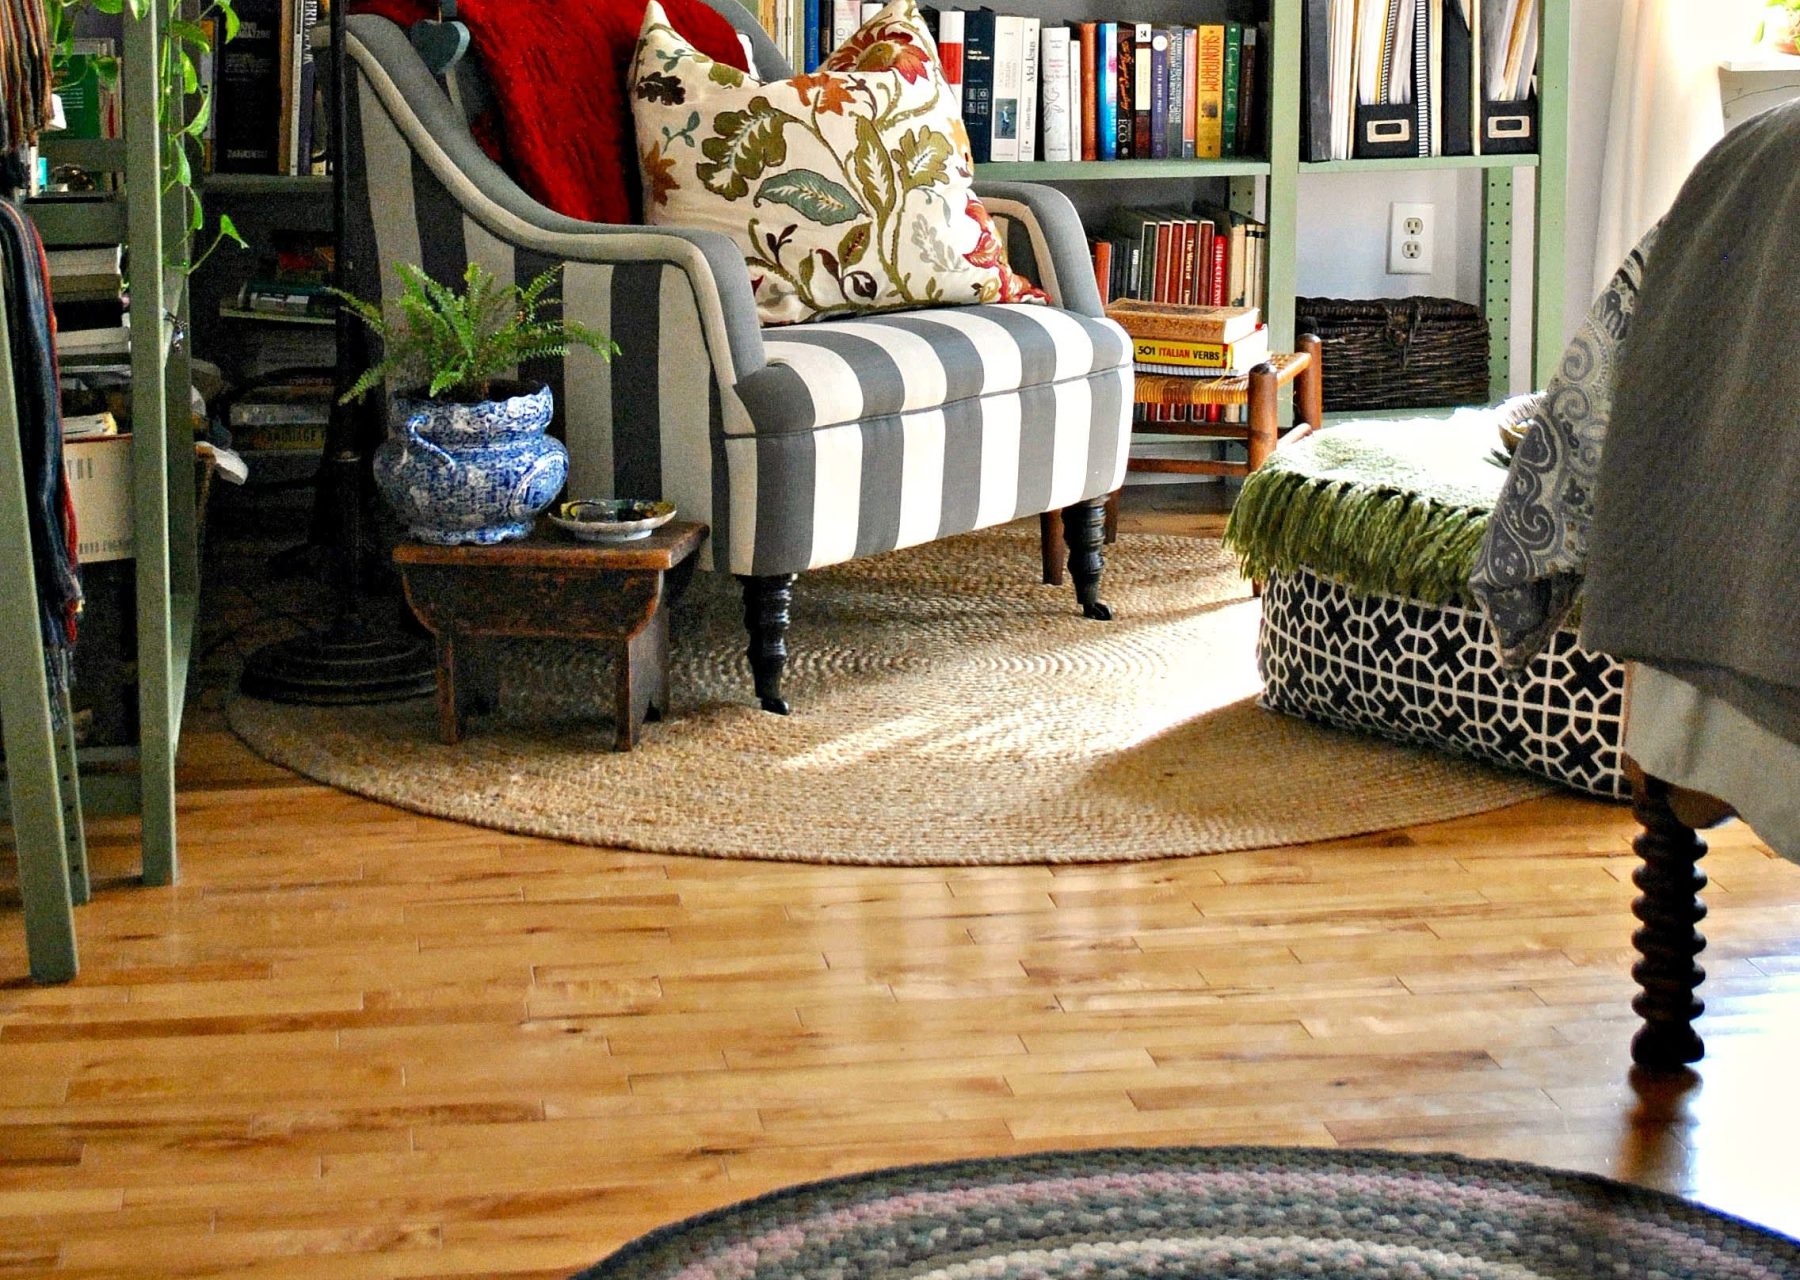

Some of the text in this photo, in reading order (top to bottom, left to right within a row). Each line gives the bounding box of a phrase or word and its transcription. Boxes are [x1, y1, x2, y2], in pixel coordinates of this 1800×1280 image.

[1199, 35, 1221, 92] SHANTARAM
[1118, 118, 1128, 142] ECO
[1186, 239, 1194, 251] The
[1186, 252, 1194, 272] World
[1137, 345, 1220, 361] 501 ITALIAN VERBS
